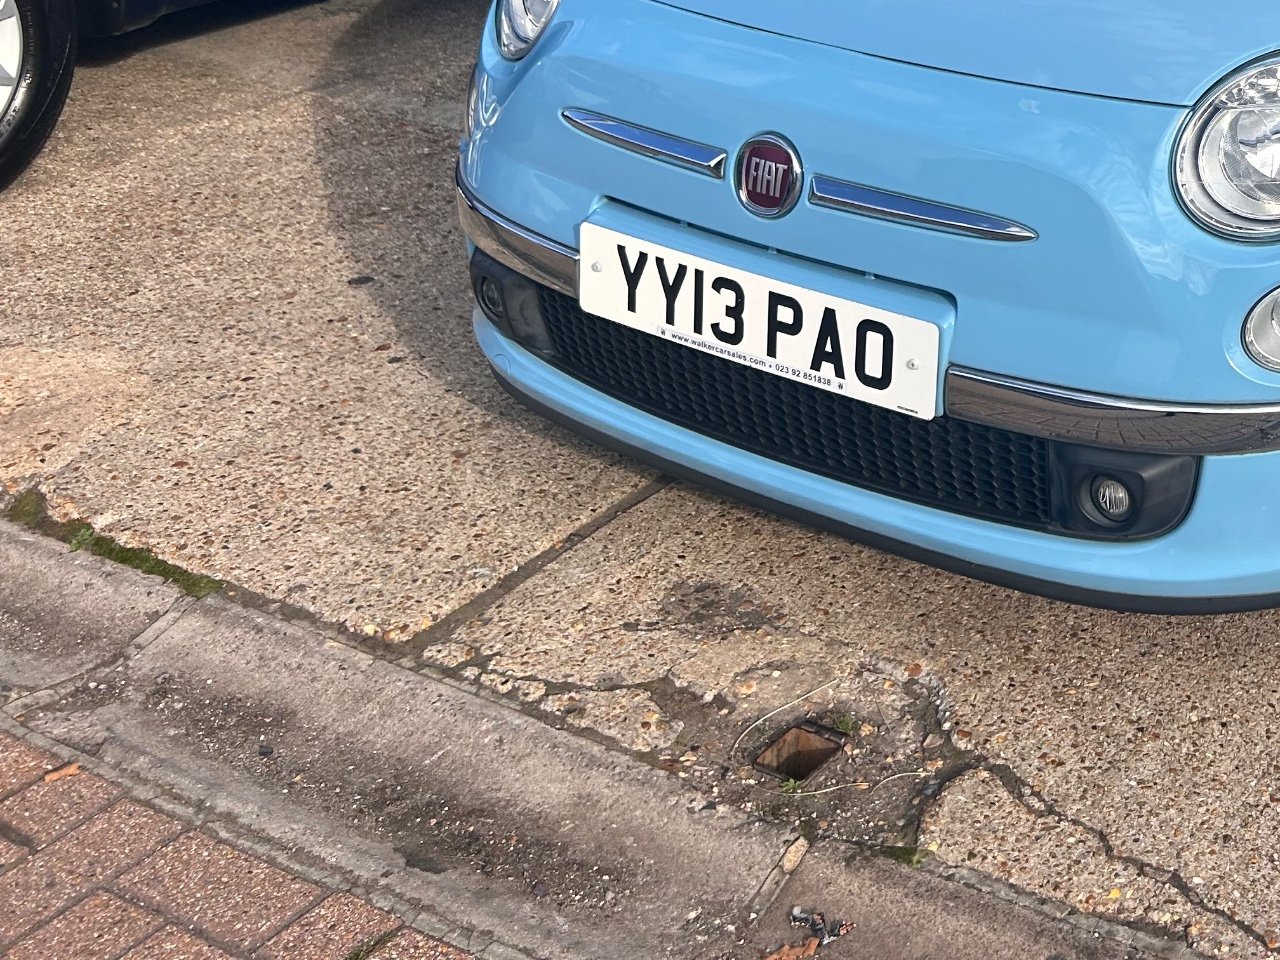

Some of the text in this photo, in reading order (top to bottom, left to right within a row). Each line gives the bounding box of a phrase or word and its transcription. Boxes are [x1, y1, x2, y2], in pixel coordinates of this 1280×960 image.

[748, 156, 788, 198] FIAT
[617, 244, 894, 391] YY13 PAO
[671, 332, 767, 368] www.walkercarsales.com
[775, 363, 789, 375] 023
[791, 368, 802, 378] 92
[802, 369, 832, 387] 851838
